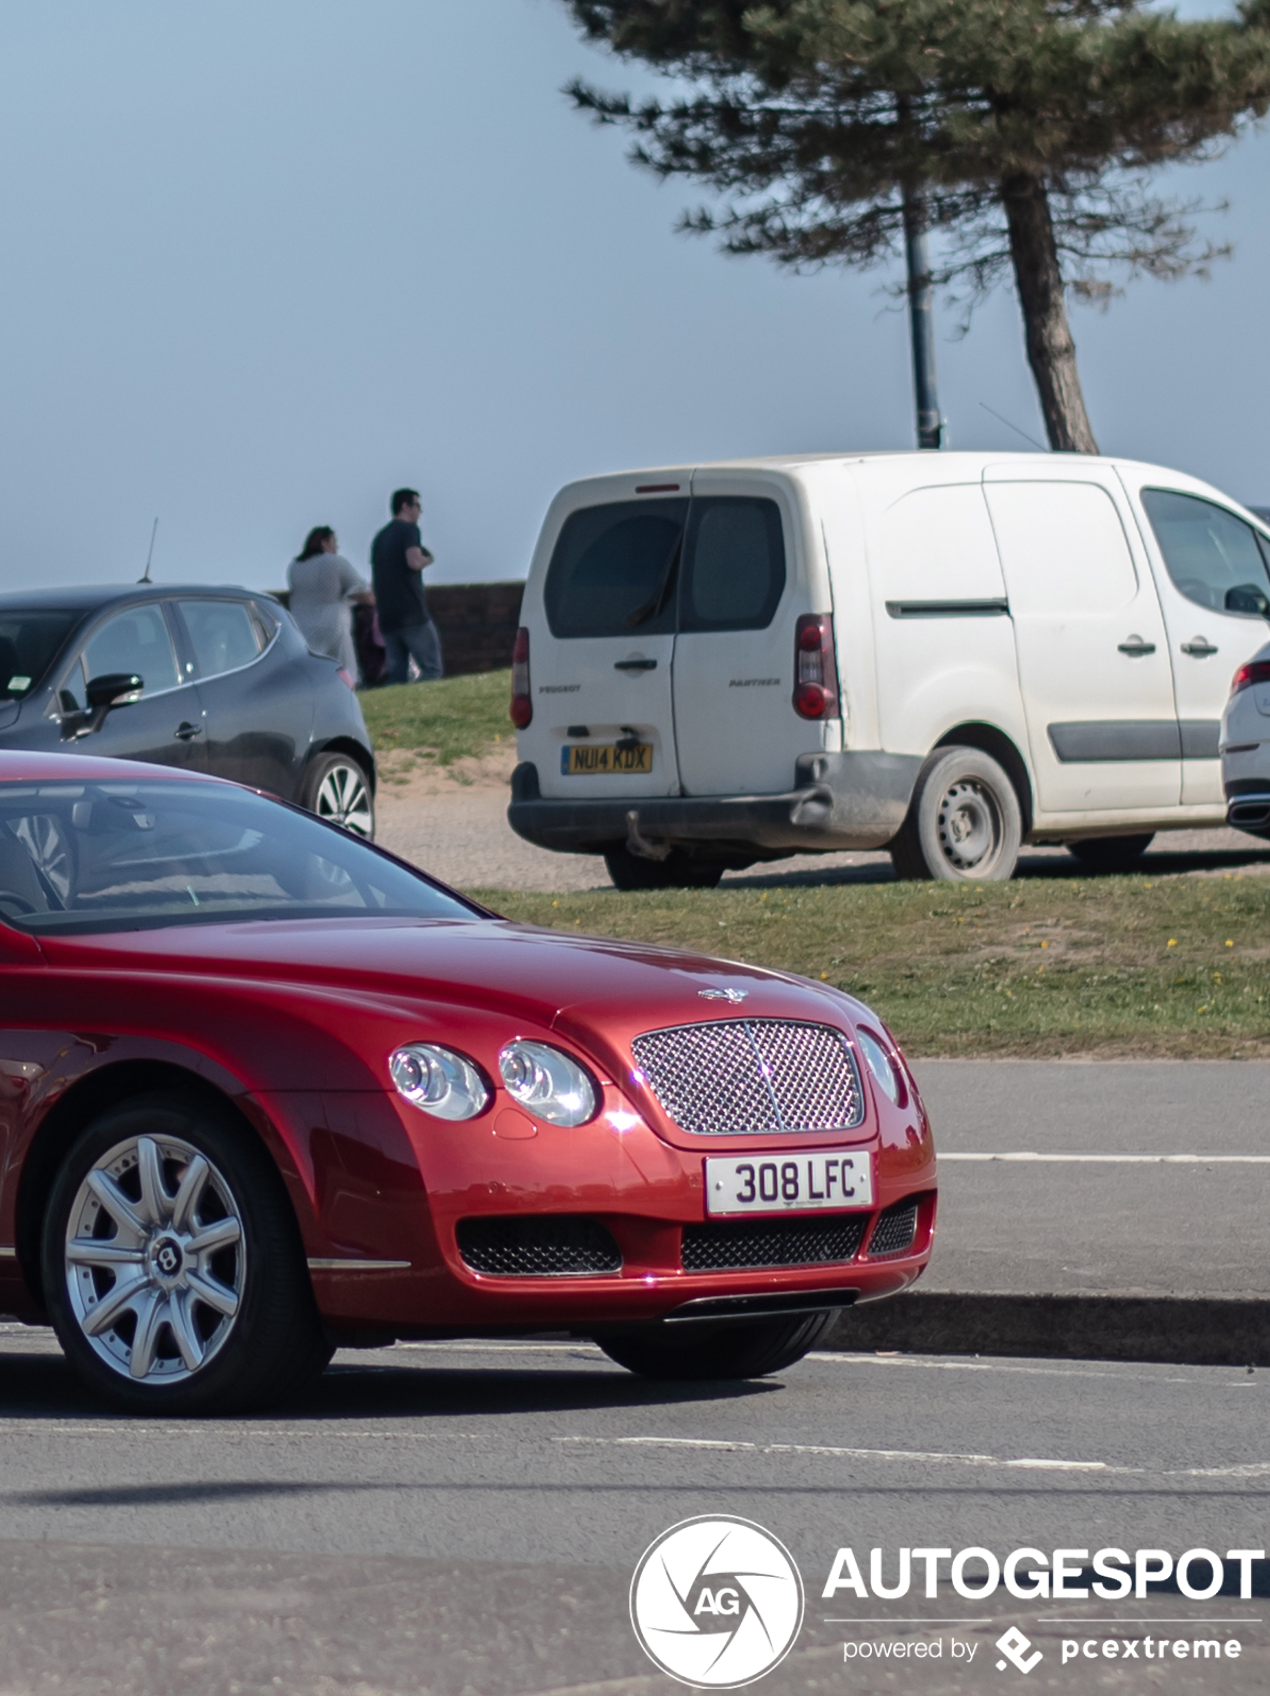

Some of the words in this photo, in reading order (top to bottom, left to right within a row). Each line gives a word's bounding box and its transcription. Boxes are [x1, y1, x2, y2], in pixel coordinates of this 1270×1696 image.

[538, 684, 581, 694] PEUGEOT
[728, 677, 781, 688] PARTNER
[574, 748, 608, 770] NU14
[612, 746, 647, 769] KDX
[735, 1161, 799, 1203] 308
[807, 1159, 855, 1200] LFC
